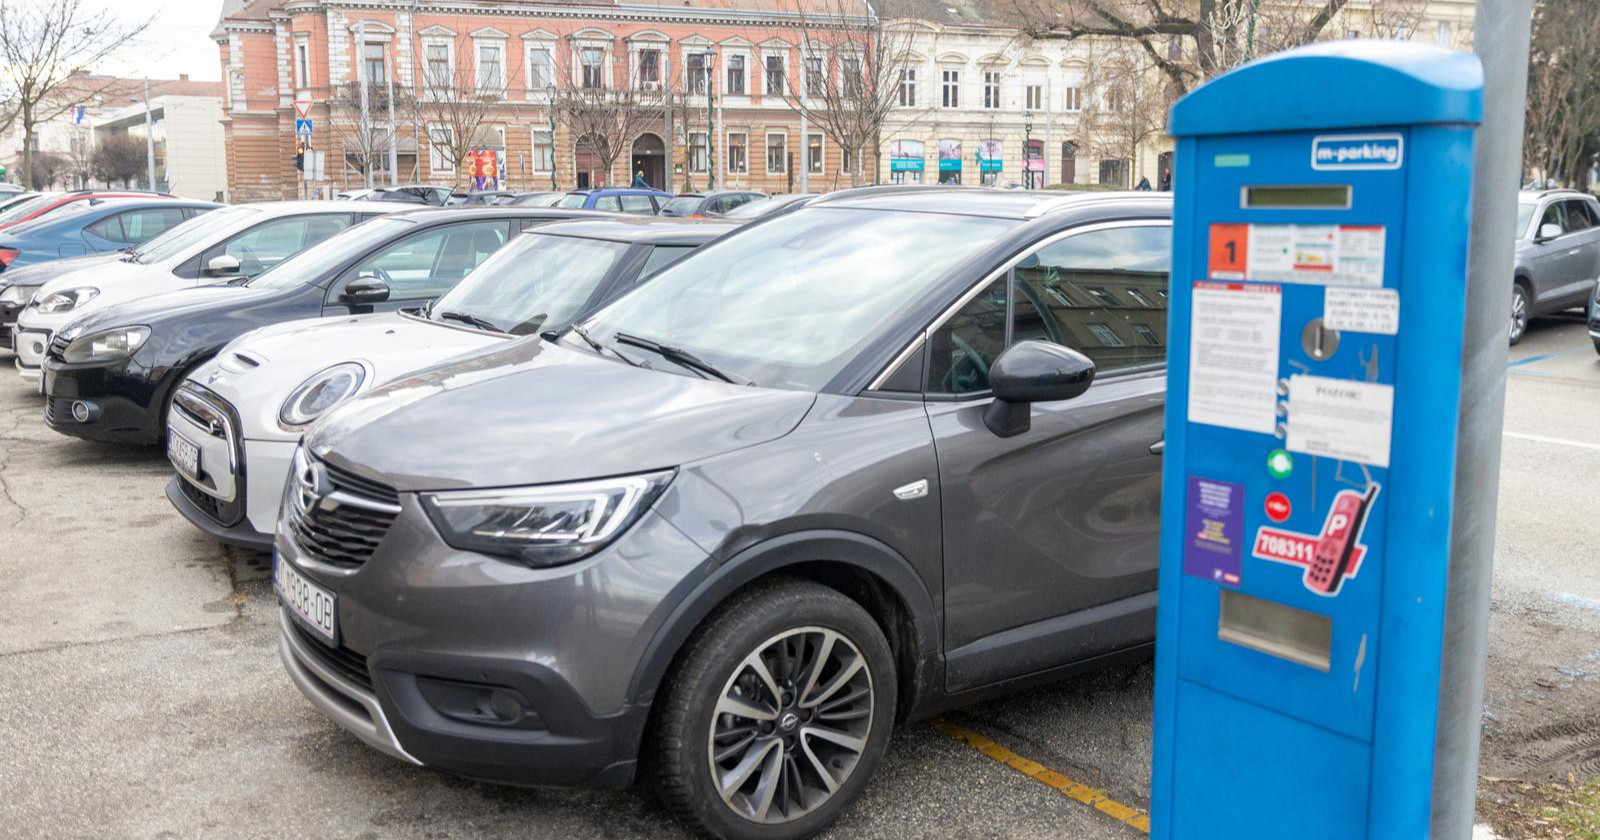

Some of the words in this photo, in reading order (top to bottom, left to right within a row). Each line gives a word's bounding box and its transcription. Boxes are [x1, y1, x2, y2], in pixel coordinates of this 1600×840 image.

[1317, 143, 1396, 162] m-parking
[1225, 239, 1236, 264] 1
[1327, 513, 1348, 536] P
[1260, 535, 1313, 561] 708311
